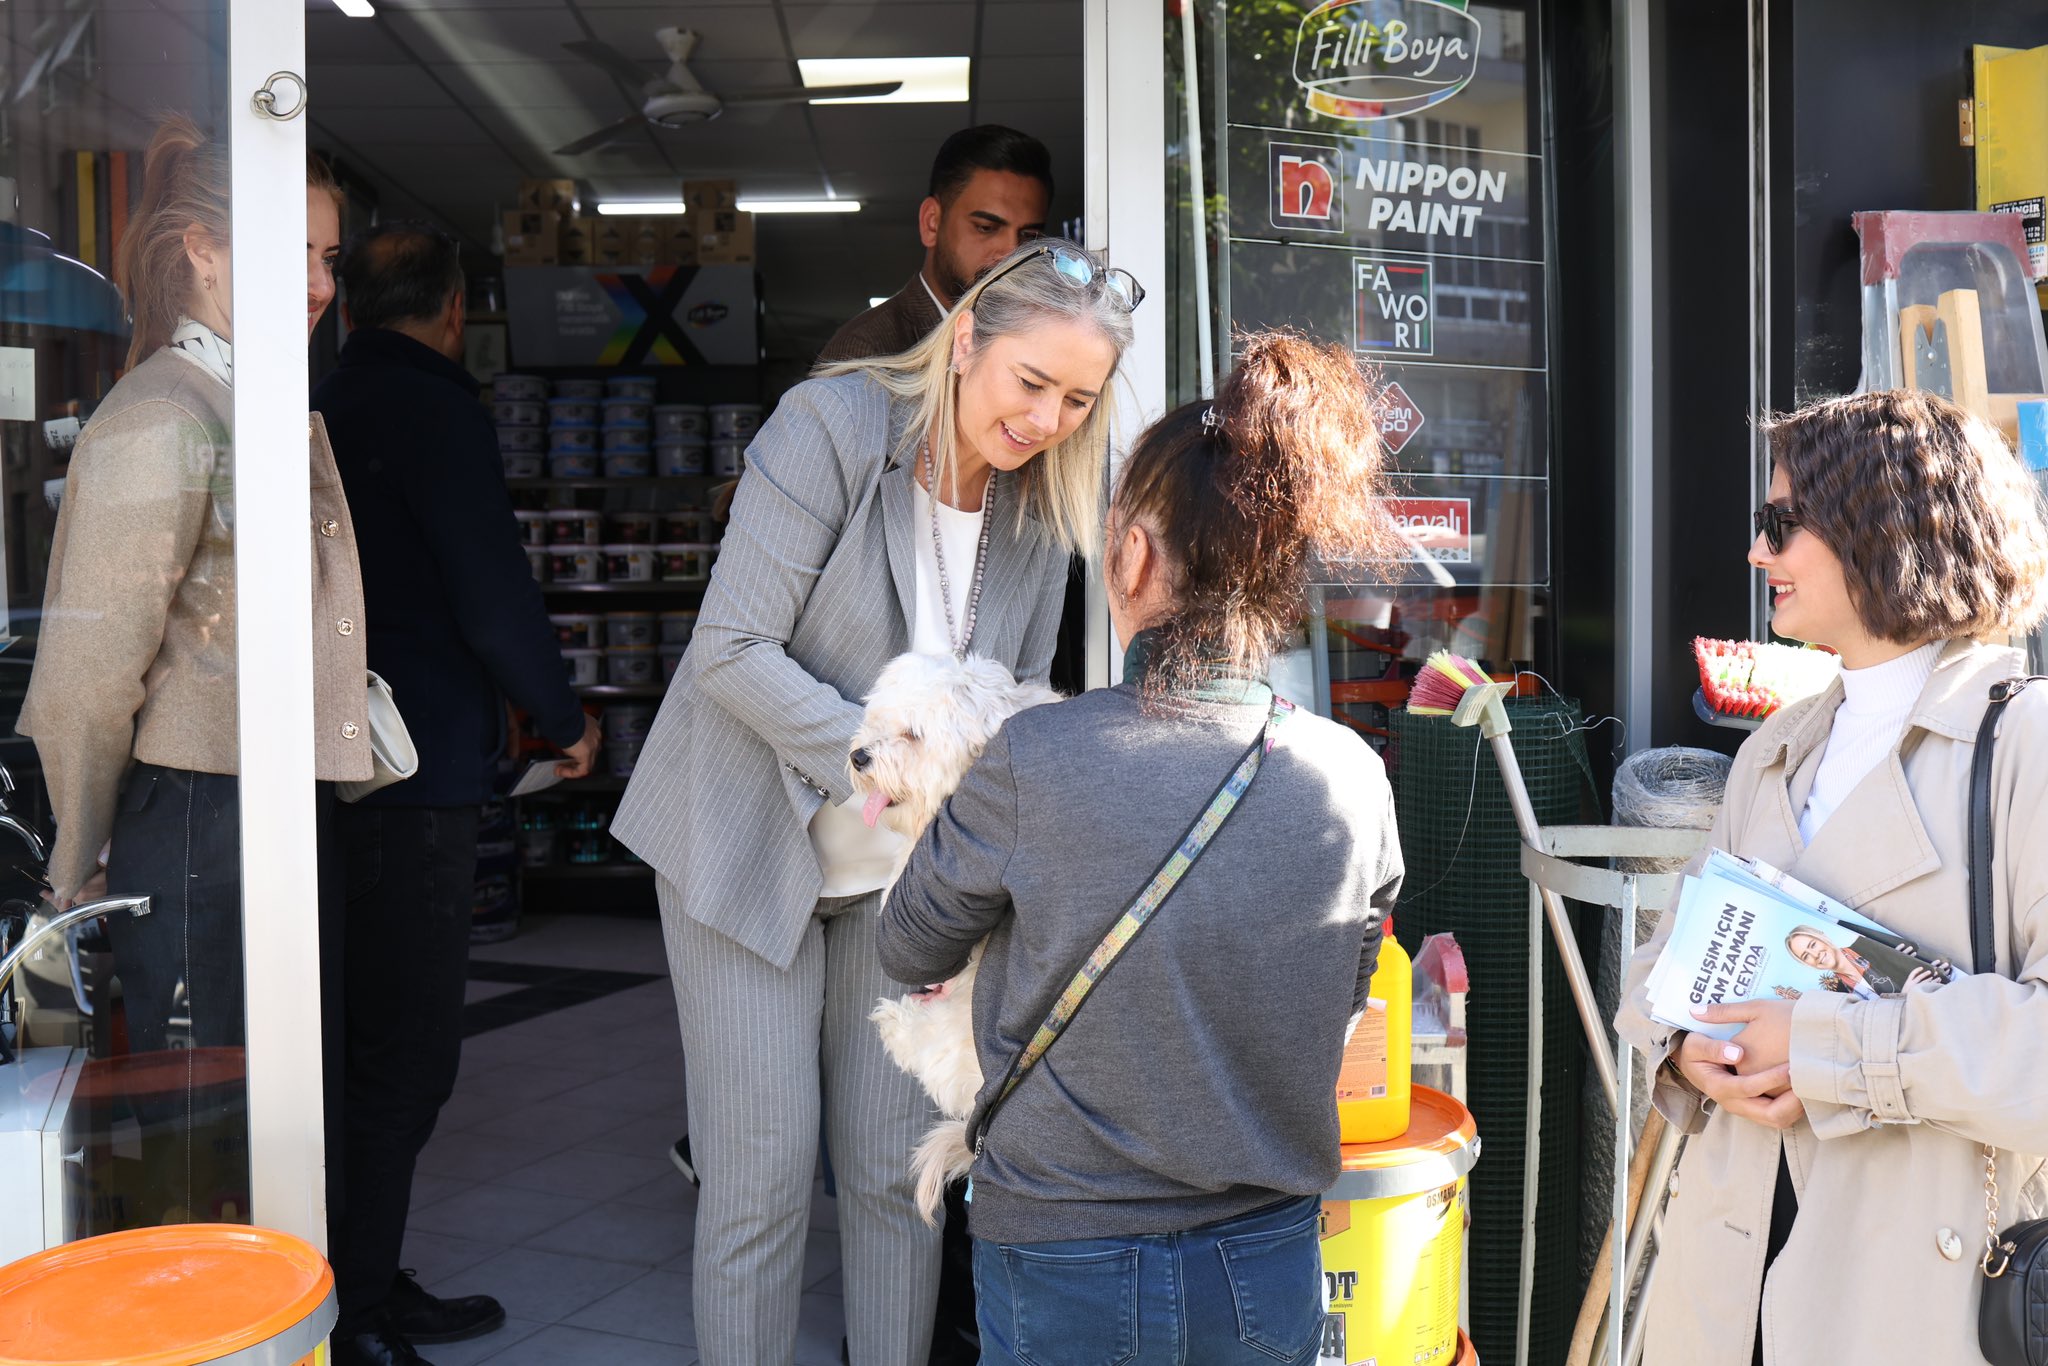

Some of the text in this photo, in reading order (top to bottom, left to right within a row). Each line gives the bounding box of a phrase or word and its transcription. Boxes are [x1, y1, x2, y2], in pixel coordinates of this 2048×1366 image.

[1311, 19, 1469, 77] Filli Boya
[1355, 157, 1507, 203] NIPPON
[1368, 197, 1483, 238] PAINT
[1707, 977, 1730, 1004] AM
[1720, 910, 1756, 976] ZAMANI
[1325, 1271, 1359, 1301] OT
